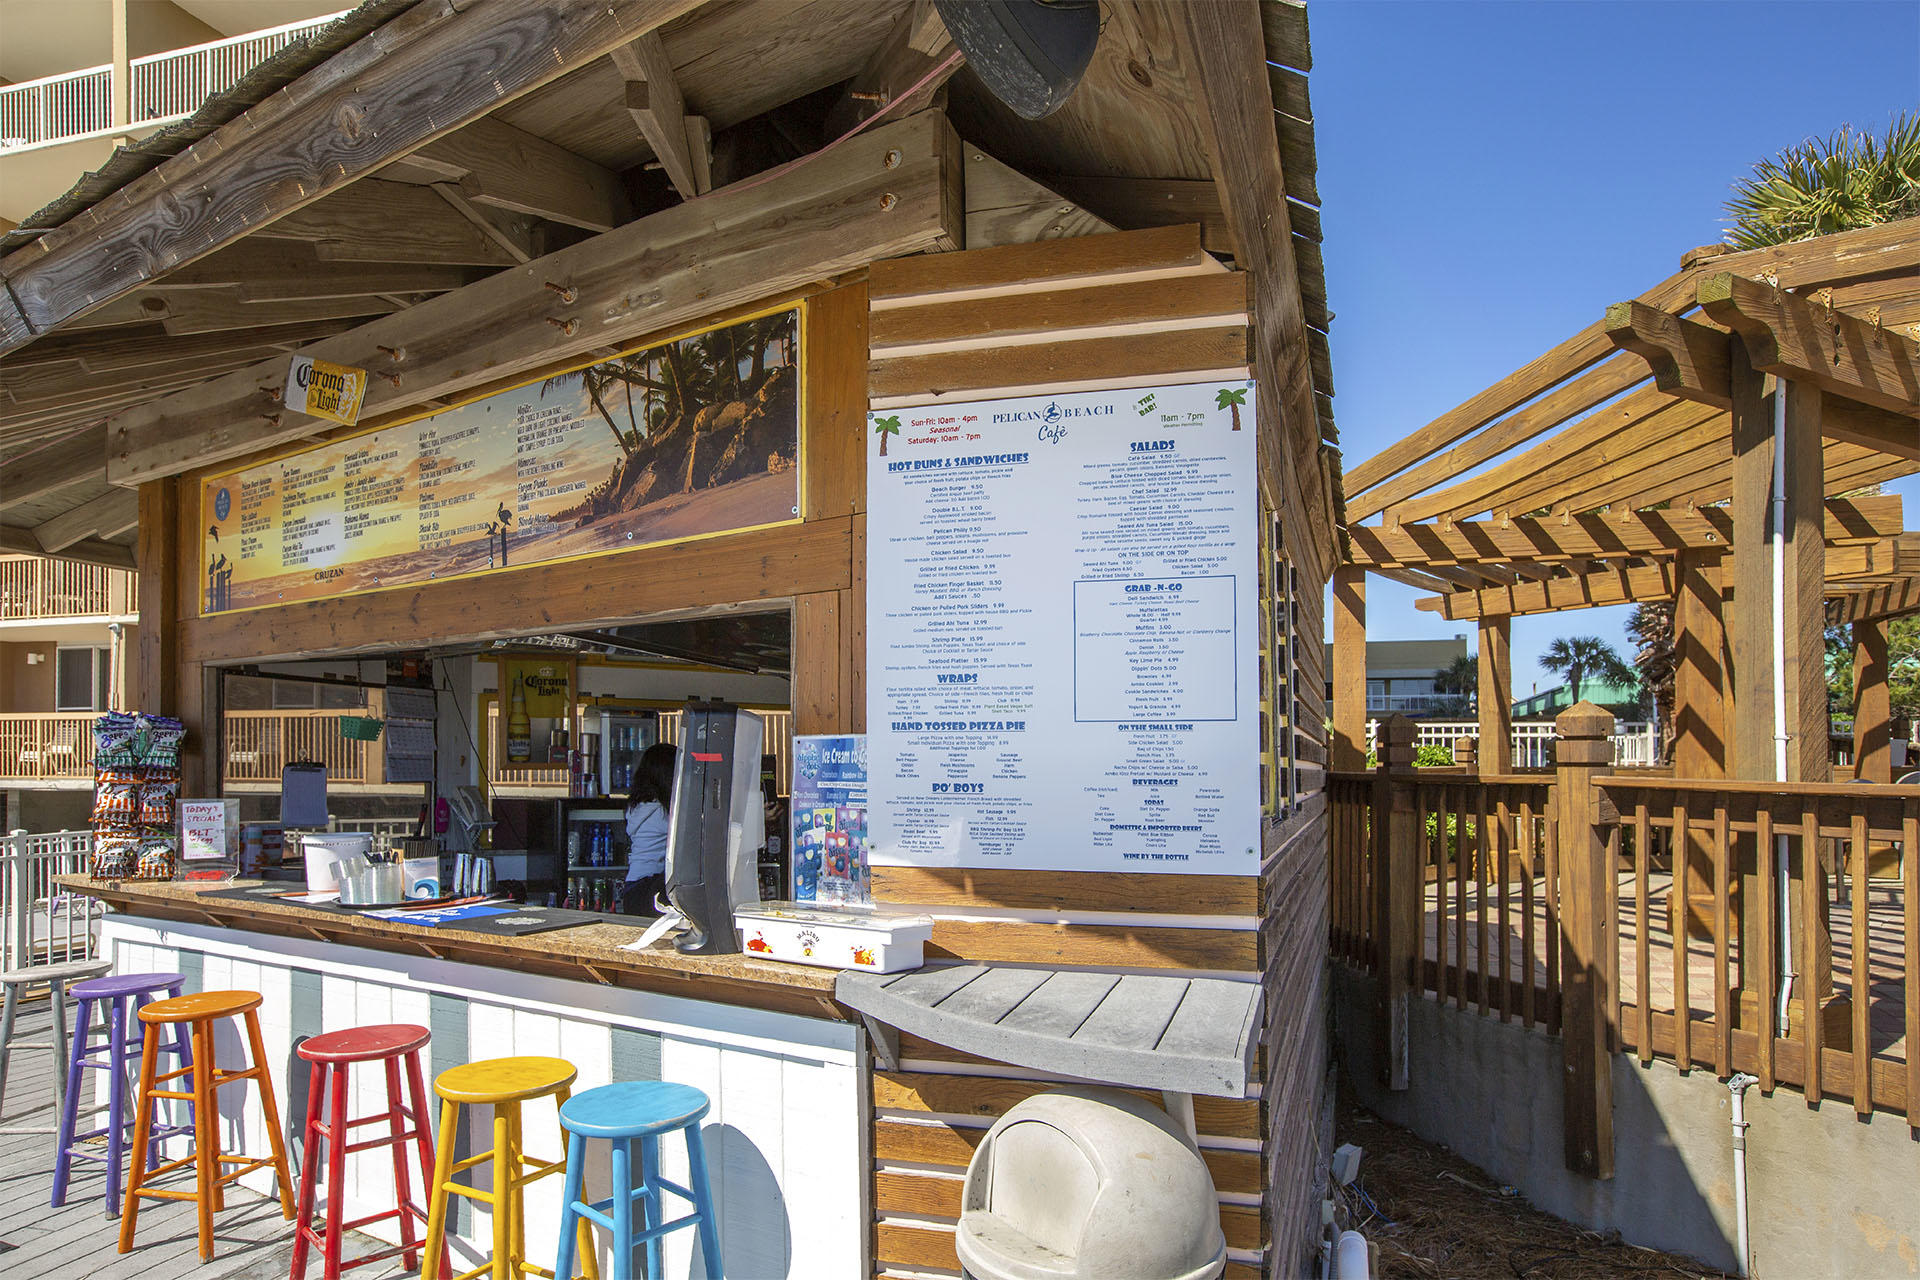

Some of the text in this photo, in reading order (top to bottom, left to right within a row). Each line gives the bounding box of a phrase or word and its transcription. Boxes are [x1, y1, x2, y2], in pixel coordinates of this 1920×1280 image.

[296, 363, 345, 393] Corona
[316, 388, 342, 412] Light
[1138, 393, 1154, 406] TIKI
[993, 405, 1114, 423] PELICAN BEACH
[1138, 402, 1158, 416] BAR!
[937, 416, 955, 424] 10am
[962, 414, 977, 423] 4pm
[1160, 413, 1178, 422] 11am
[1187, 411, 1204, 421] 7pm
[929, 425, 960, 433] Seasonal
[1130, 439, 1174, 452] SALADS
[888, 452, 1028, 471] HOT BUNS & SANDWICHES
[314, 568, 344, 581] CRUZAN
[526, 675, 568, 688] Corona
[937, 673, 977, 683] WRAPS
[538, 686, 560, 696] Light
[891, 721, 1025, 731] HAND TOSSED PIZZA PIE
[822, 748, 831, 764] Ice
[831, 748, 850, 764] Cream
[932, 783, 983, 792] PO' BOYS
[188, 828, 214, 836] BLT
[796, 930, 820, 942] MALIBU
